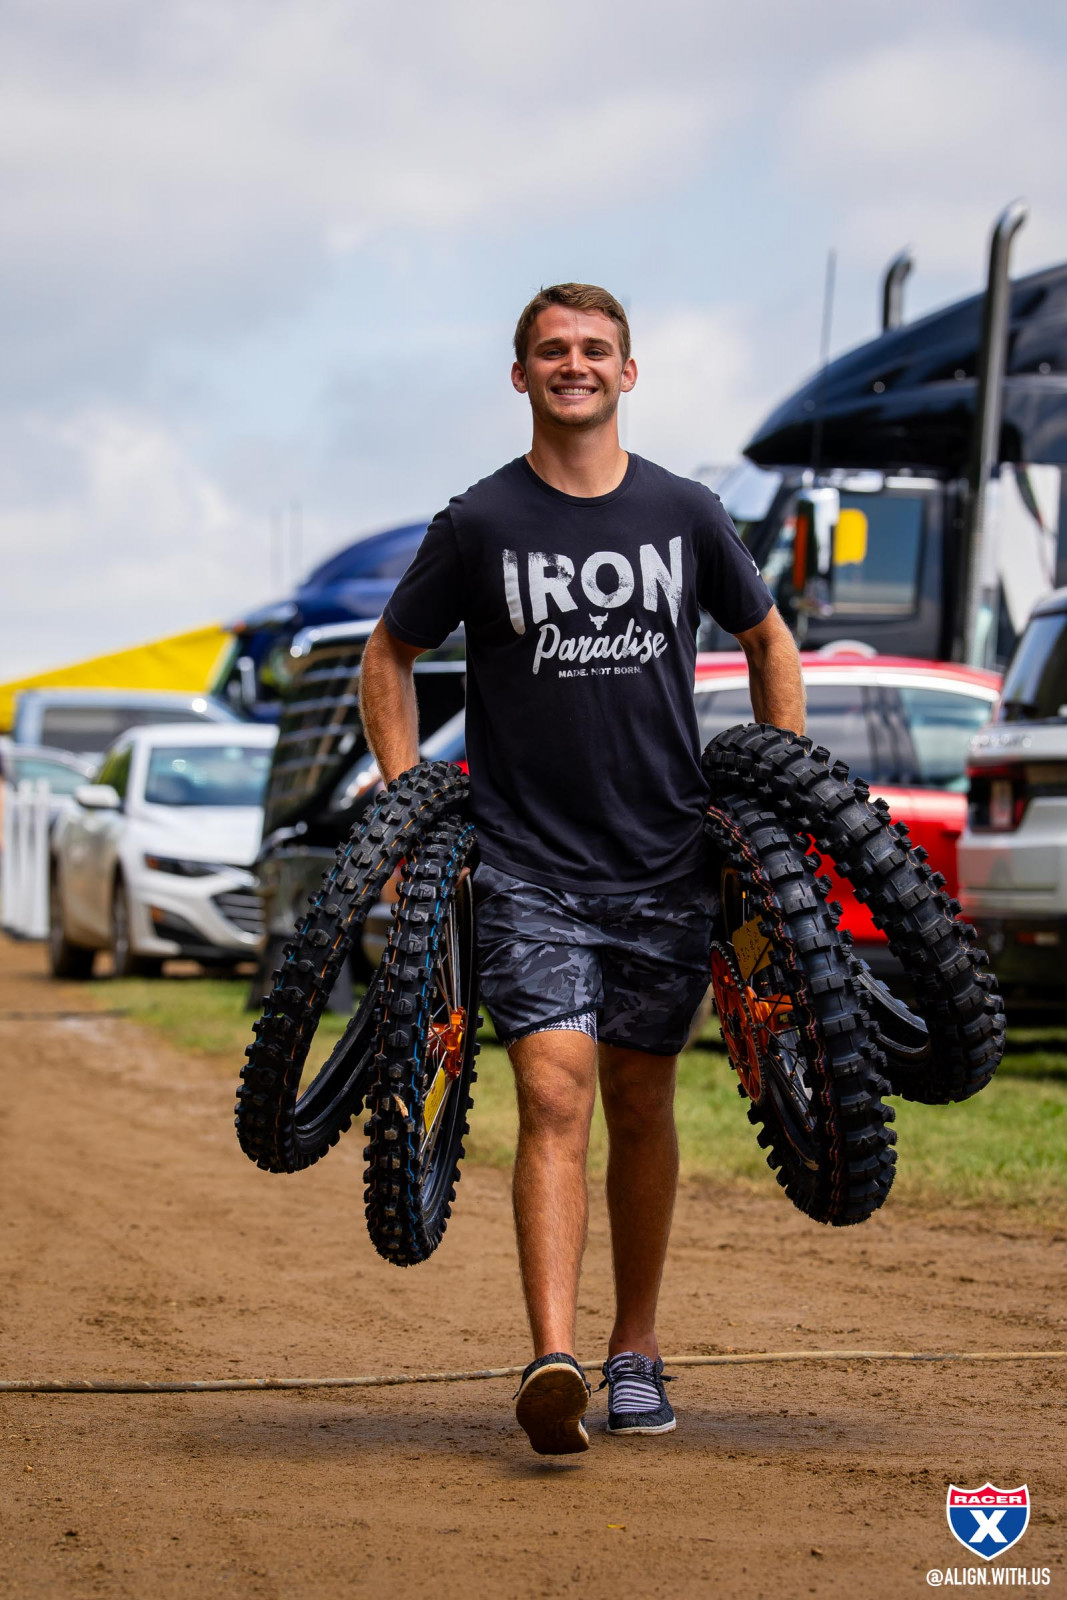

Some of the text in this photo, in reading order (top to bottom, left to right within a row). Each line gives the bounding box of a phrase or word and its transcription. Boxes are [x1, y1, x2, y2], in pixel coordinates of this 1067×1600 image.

[502, 536, 683, 635] IRON
[532, 617, 668, 675] Paradise
[558, 668, 588, 679] MADE.
[591, 667, 612, 676] NOT
